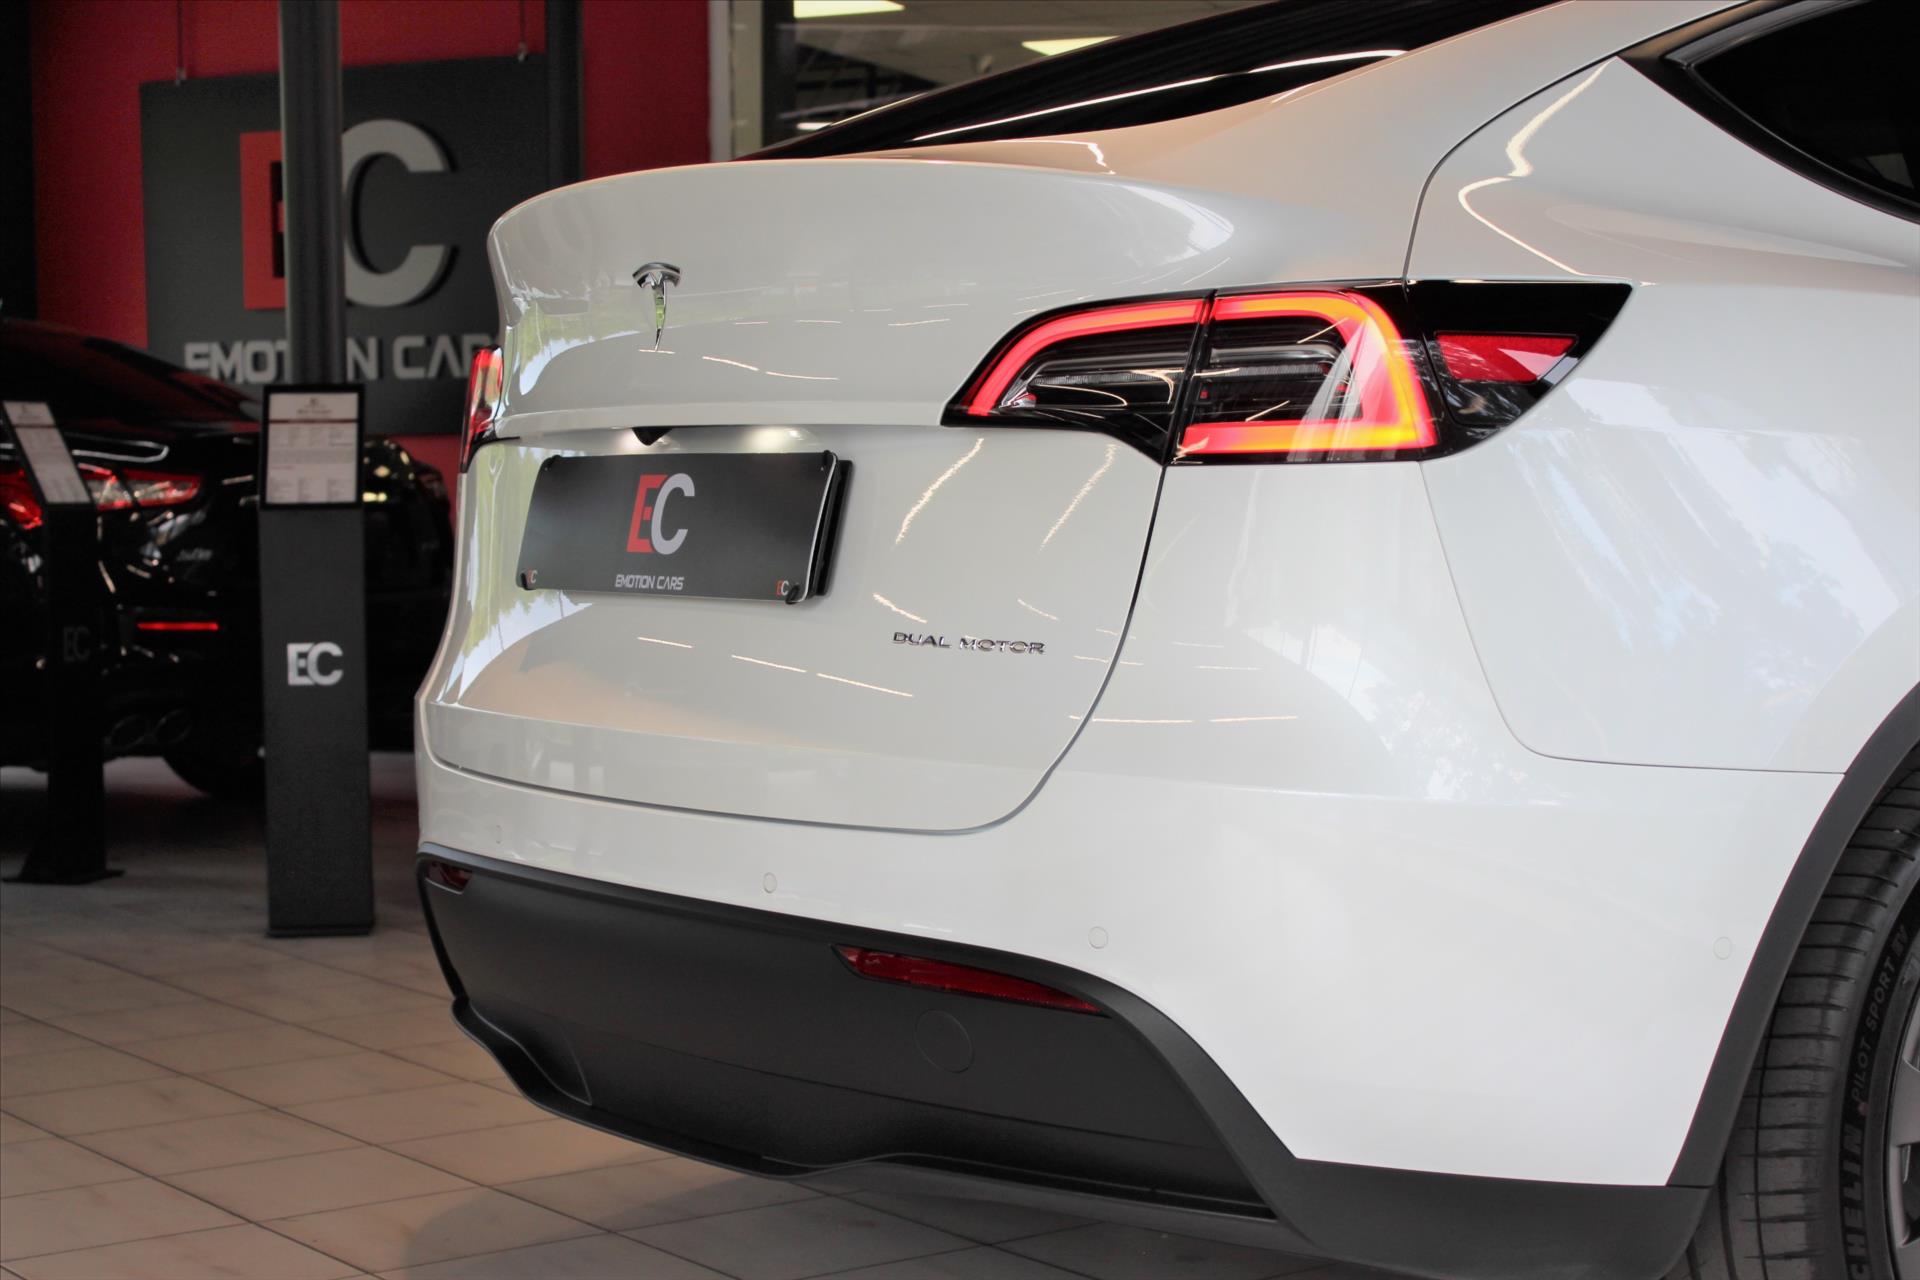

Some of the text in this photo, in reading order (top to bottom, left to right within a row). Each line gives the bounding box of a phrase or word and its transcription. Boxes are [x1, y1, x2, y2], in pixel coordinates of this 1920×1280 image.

[184, 336, 379, 384] EMOTN
[626, 473, 695, 555] EC
[615, 574, 685, 590] EMOTION CARS
[62, 625, 91, 662] EC
[287, 641, 343, 686] EC
[893, 631, 1046, 655] DUAL MOTOR
[1851, 1036, 1872, 1102] PILOT
[1865, 956, 1896, 1031] SPORT
